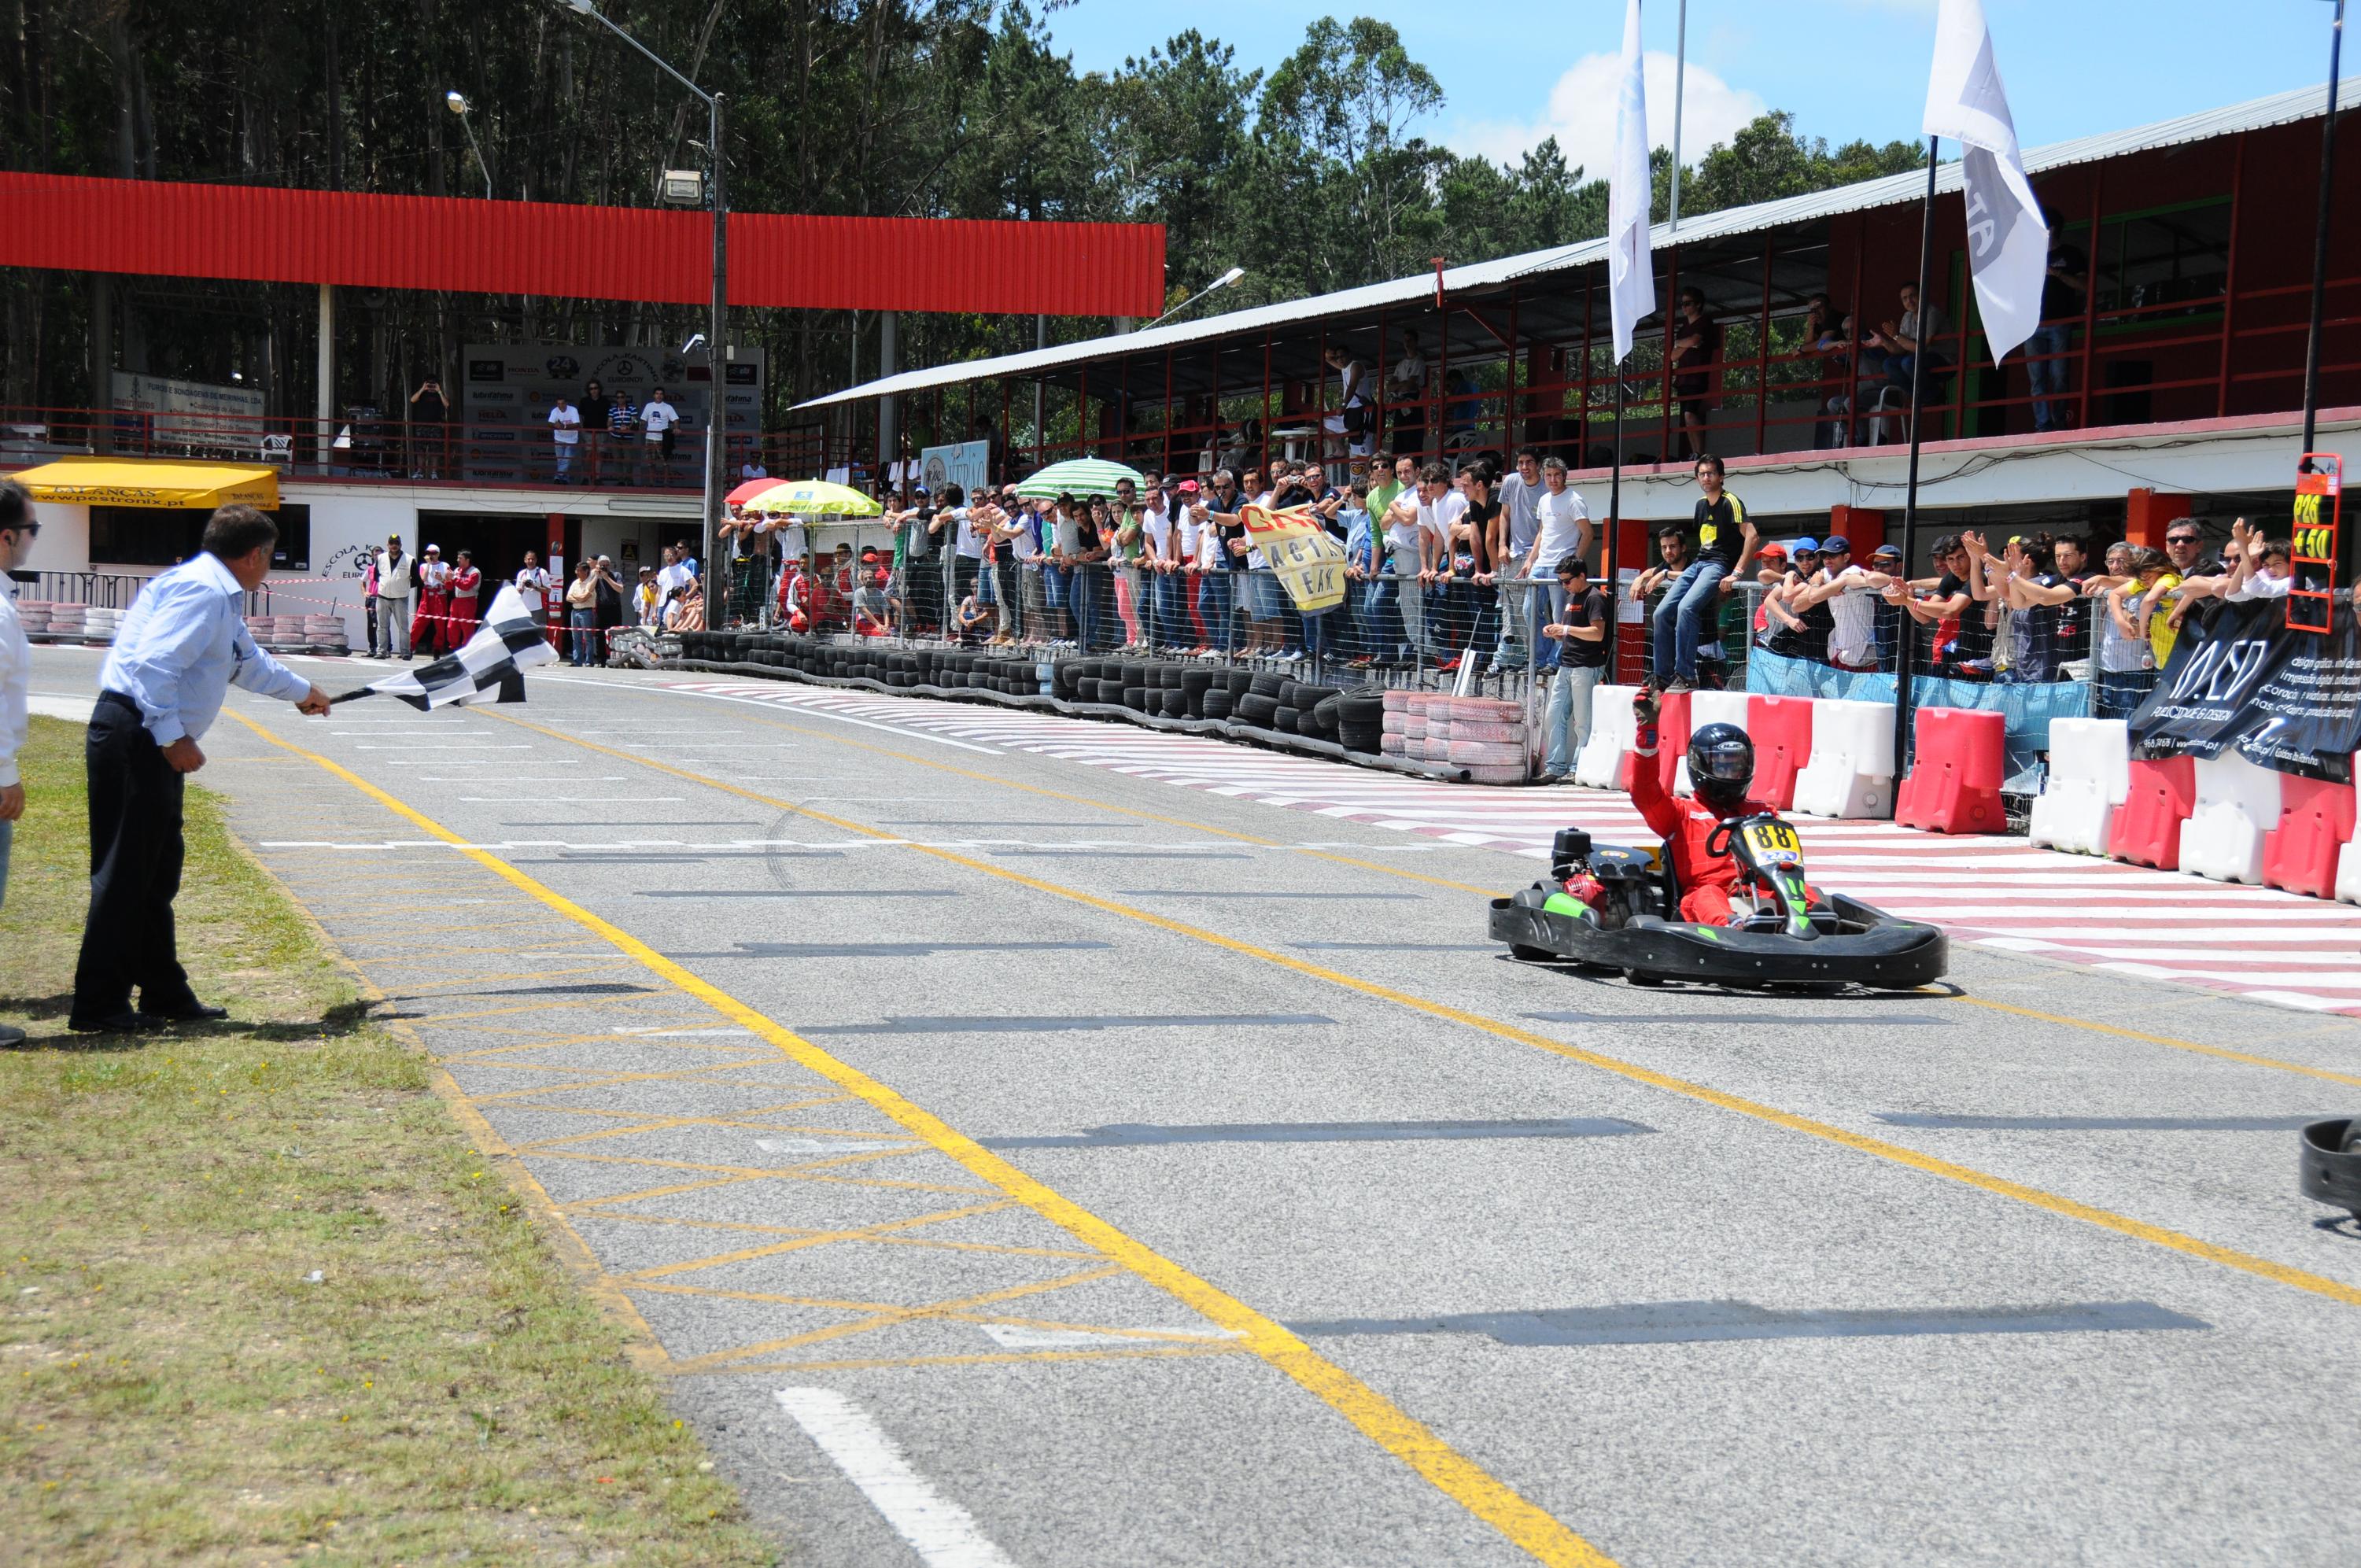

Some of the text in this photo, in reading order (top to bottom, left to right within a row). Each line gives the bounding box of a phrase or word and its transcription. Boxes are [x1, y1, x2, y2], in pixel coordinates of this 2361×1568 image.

[552, 357, 571, 370] 24
[149, 383, 168, 393] FUROS
[174, 388, 209, 398] SONDAGENS
[2293, 494, 2320, 525] P26
[322, 544, 358, 577] ESCOLA
[1754, 825, 1791, 849] 88
